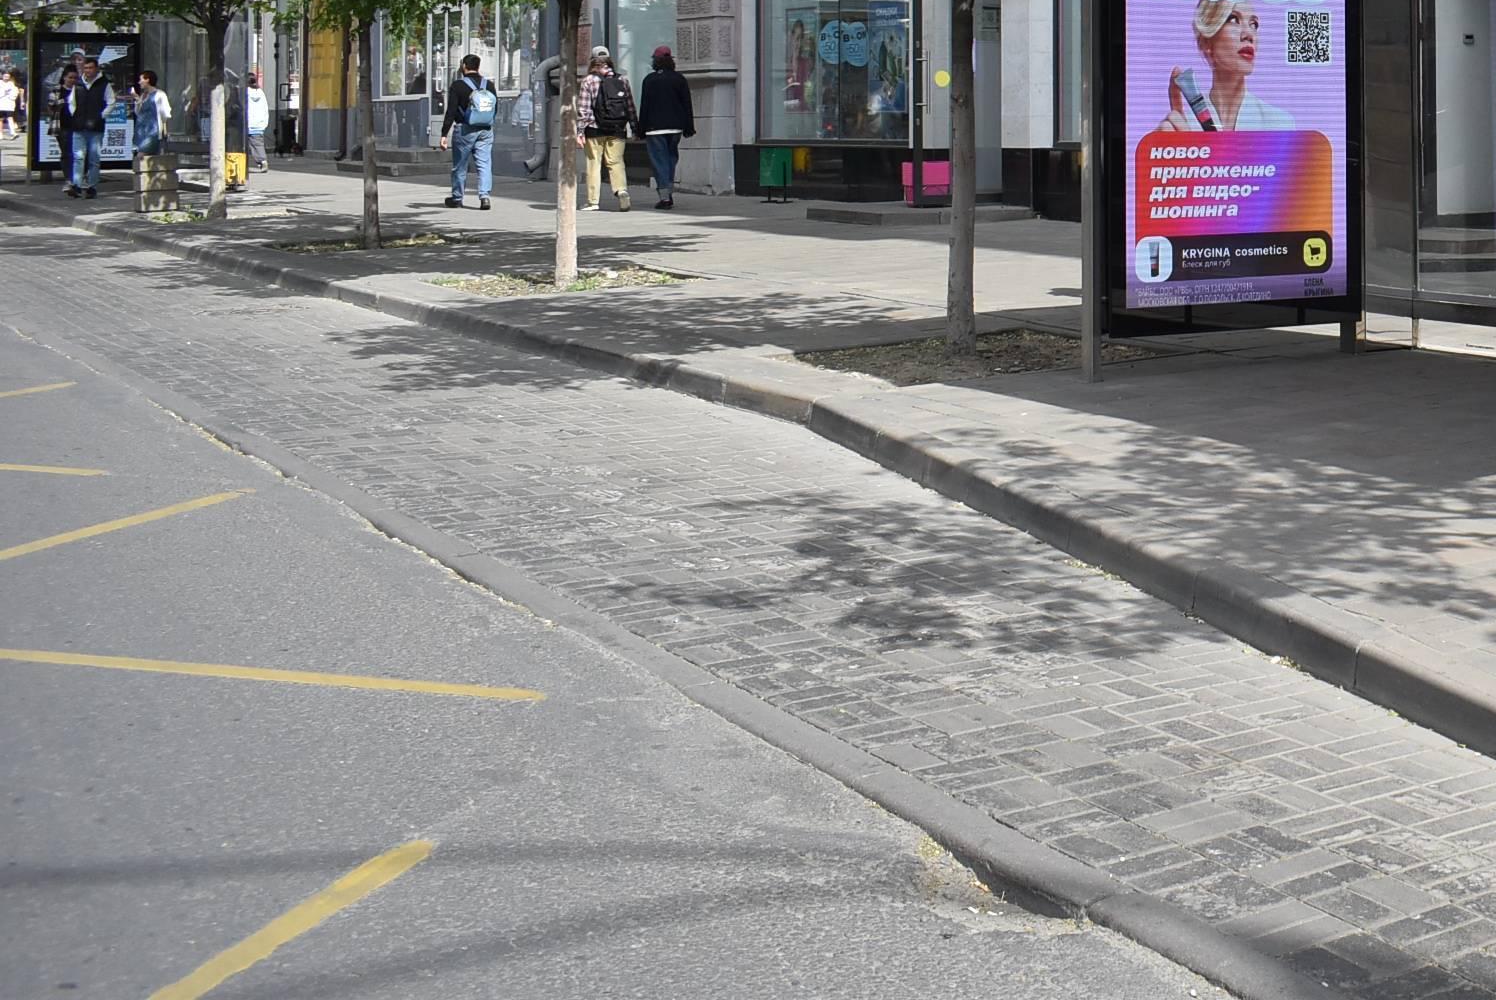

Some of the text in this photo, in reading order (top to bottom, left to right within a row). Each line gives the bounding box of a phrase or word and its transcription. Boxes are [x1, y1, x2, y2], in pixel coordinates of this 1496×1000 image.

[1150, 146, 1211, 159] новое
[1150, 164, 1276, 184] приложение
[1149, 184, 1260, 202] для видео-
[1150, 204, 1238, 219] шопинга
[1182, 244, 1288, 259] KRYGINA cosmetics
[1182, 259, 1231, 269] Блеск для губ
